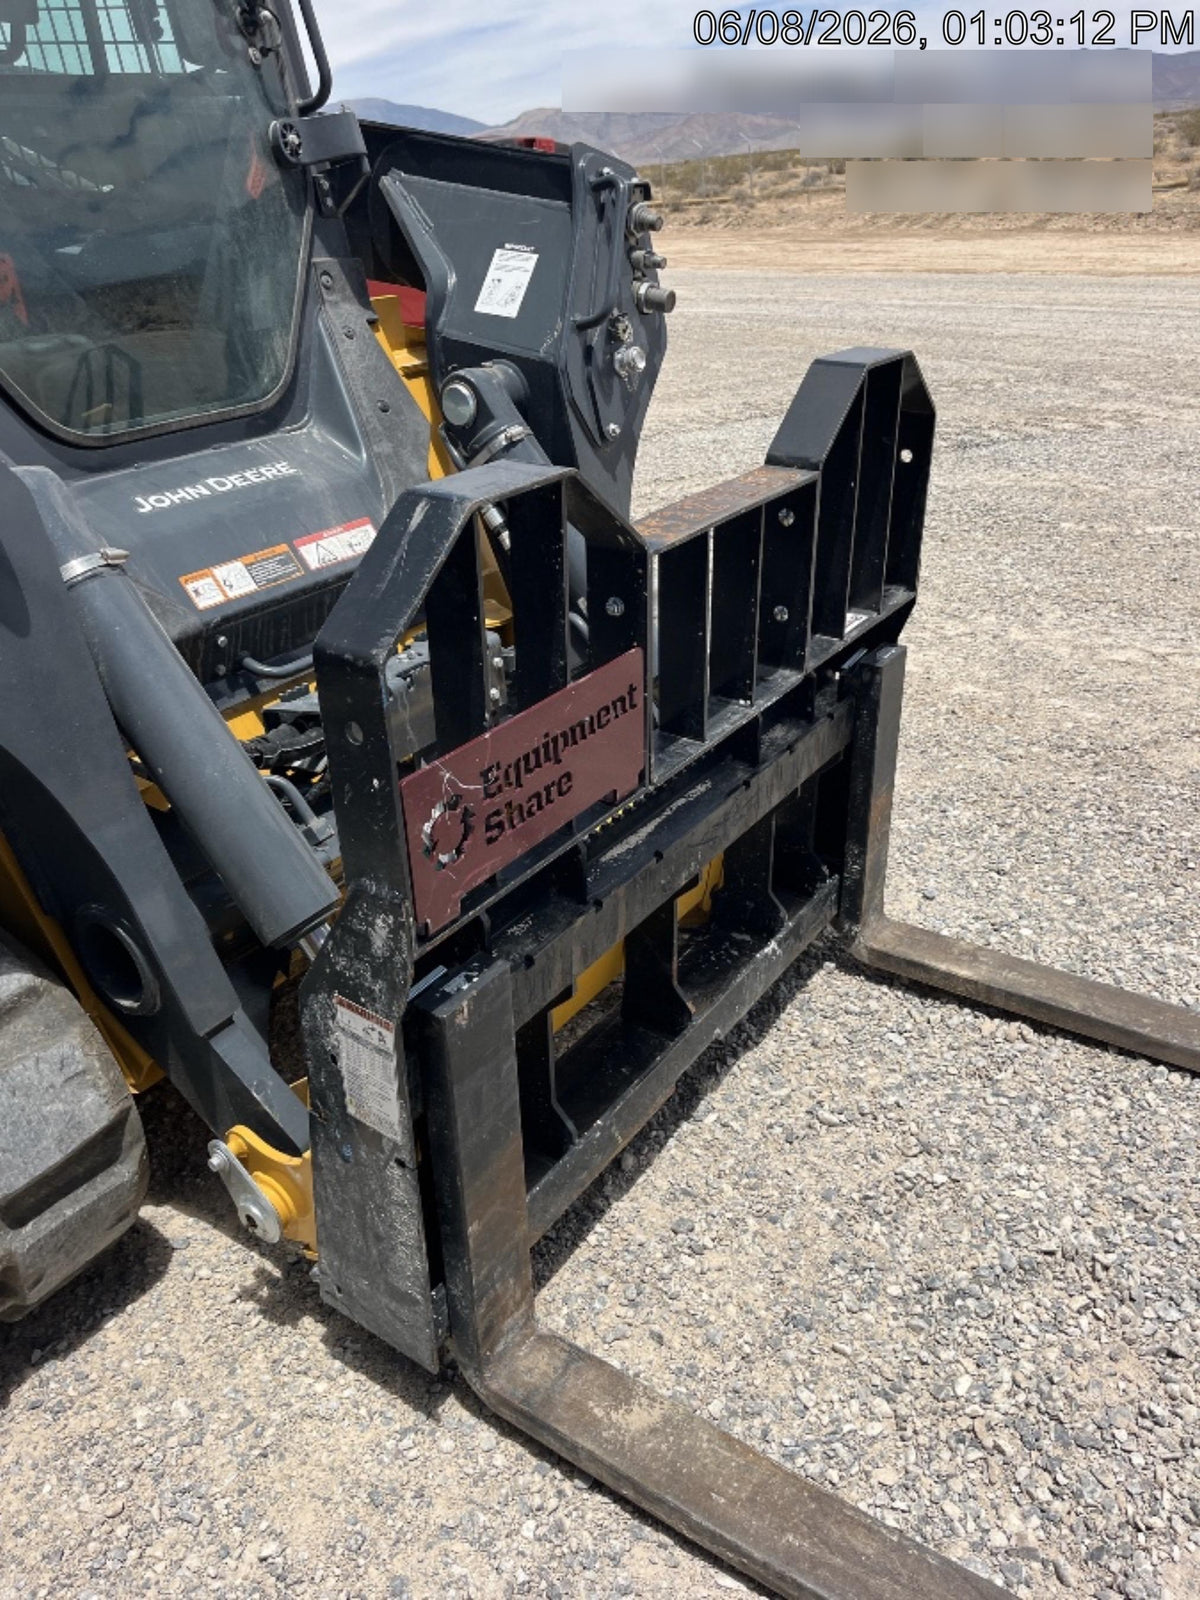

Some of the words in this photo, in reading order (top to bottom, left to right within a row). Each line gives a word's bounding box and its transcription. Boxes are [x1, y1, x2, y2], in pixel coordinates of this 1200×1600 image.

[133, 484, 212, 513] JOHN
[207, 460, 298, 492] DEERE
[480, 683, 638, 801] Equipment
[484, 770, 573, 846] Share
